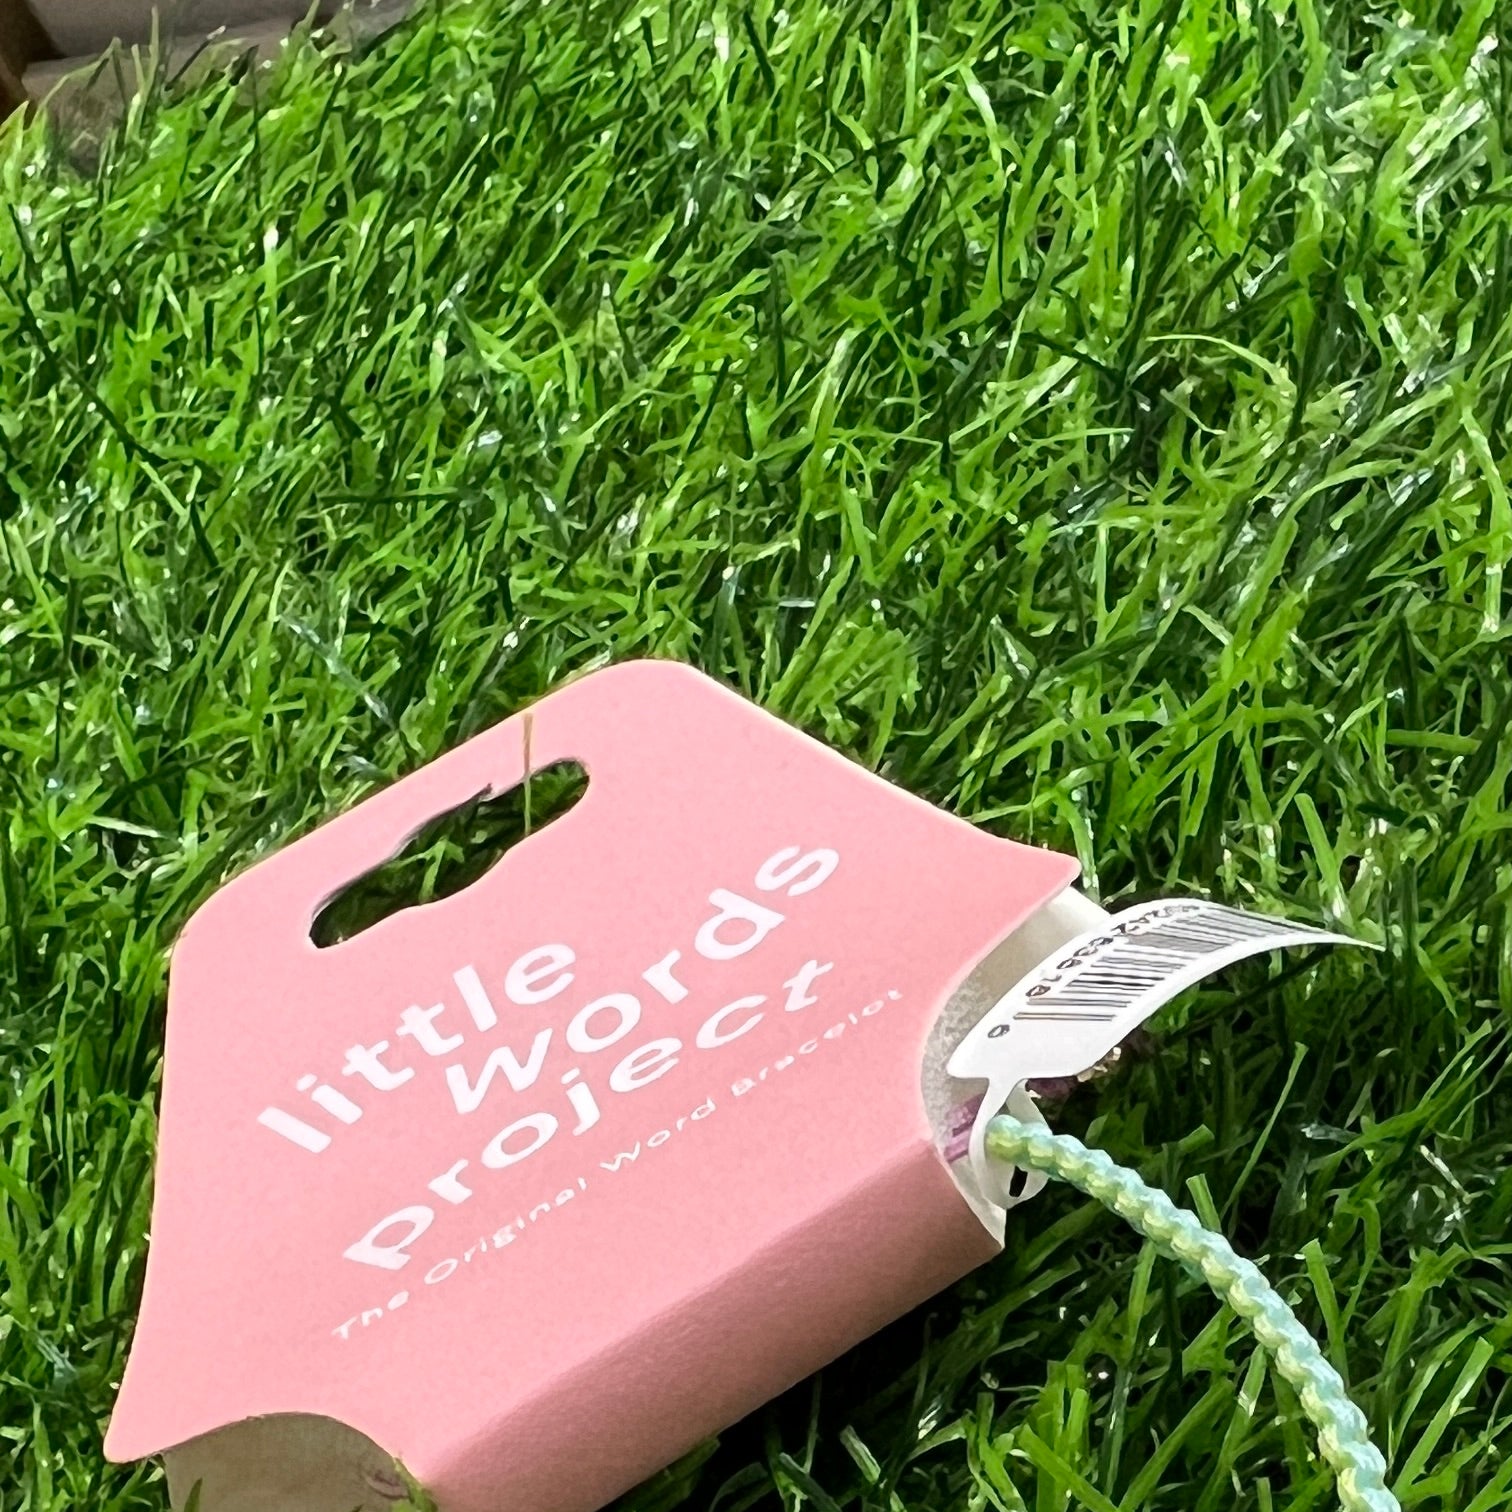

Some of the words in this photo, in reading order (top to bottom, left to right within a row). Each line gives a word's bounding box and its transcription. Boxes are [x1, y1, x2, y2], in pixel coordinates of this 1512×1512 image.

[256, 942, 576, 1155] little
[445, 844, 840, 1116] words
[331, 1289, 410, 1339] The
[423, 1176, 588, 1285] Original
[599, 1096, 717, 1173] Word
[342, 956, 837, 1272] project
